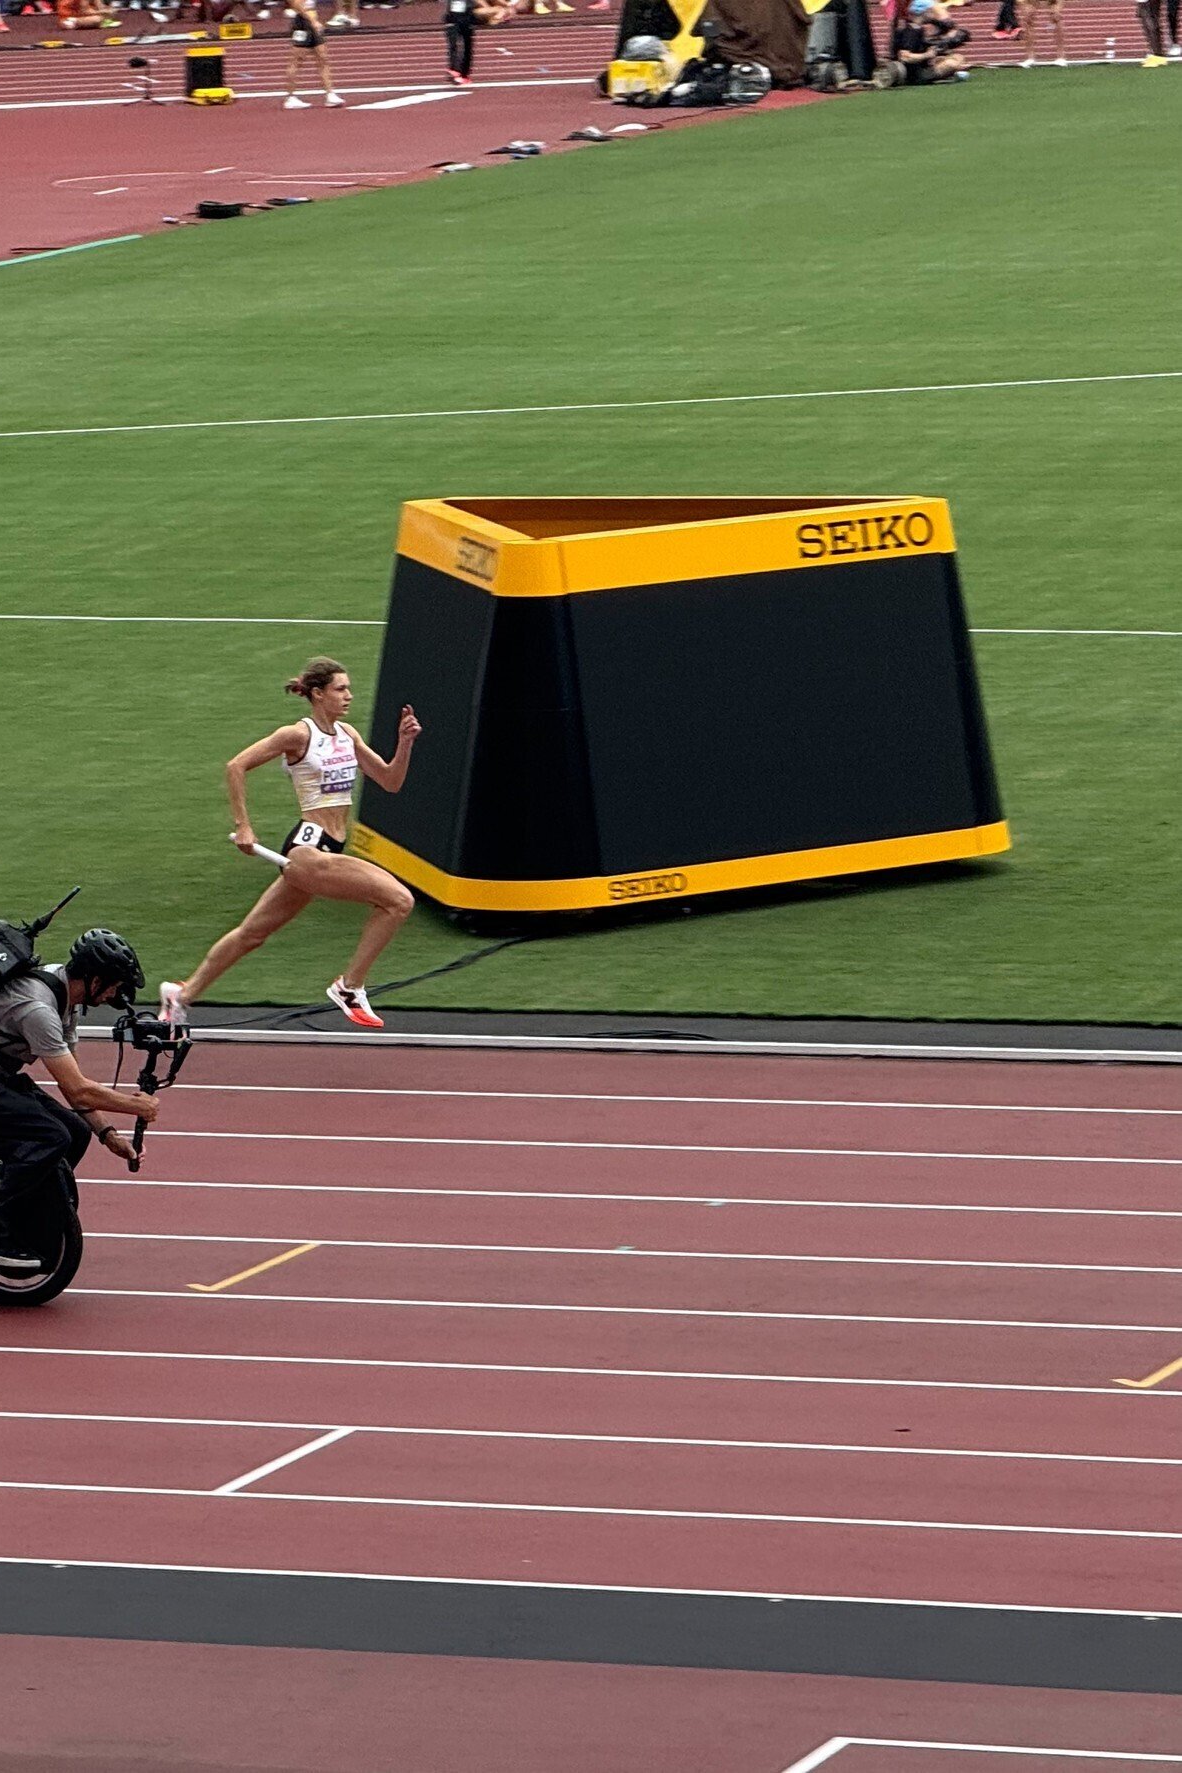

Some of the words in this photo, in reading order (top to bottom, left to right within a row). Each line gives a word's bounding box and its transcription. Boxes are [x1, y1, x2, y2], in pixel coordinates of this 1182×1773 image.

[796, 512, 934, 558] SEIKO
[302, 826, 315, 843] 8
[607, 872, 688, 900] SEIKO
